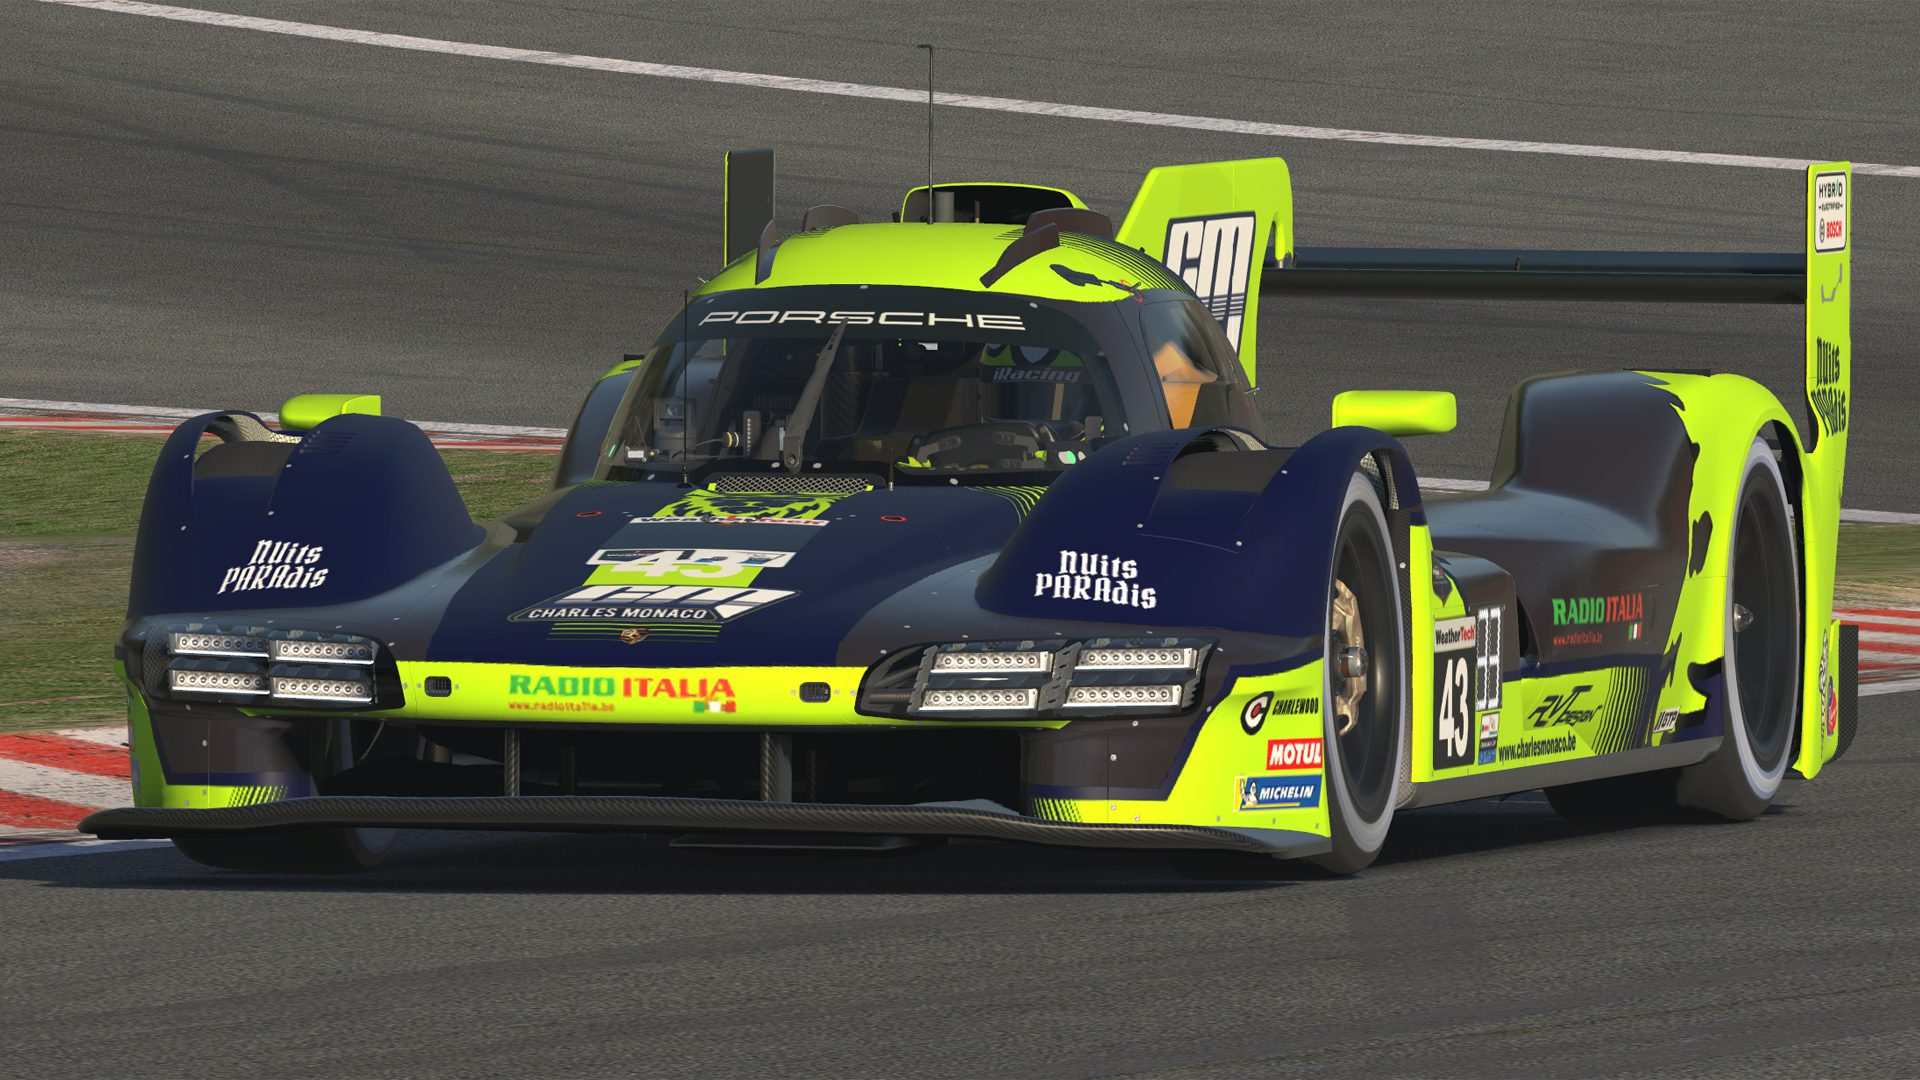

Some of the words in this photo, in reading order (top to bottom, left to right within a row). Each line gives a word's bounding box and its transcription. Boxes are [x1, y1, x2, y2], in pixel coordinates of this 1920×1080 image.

[1826, 221, 1842, 239] BOSCH
[698, 310, 1026, 331] PORSCHE
[992, 367, 1081, 383] iRacing
[611, 550, 744, 579] 43
[528, 607, 617, 619] CHARLES
[621, 607, 707, 620] MONACO
[1552, 597, 1605, 625] RADIO
[1605, 592, 1643, 623] ITALIA
[1435, 625, 1475, 645] WeatherTech
[509, 674, 615, 696] RADIO
[623, 677, 736, 698] ITALIA
[509, 700, 615, 712] www.radioitalia.be
[1272, 697, 1319, 716] CHARLEWOOD
[1438, 657, 1469, 758] 43
[1269, 742, 1322, 766] MOTUL
[1499, 730, 1577, 762] www.charlesmonaco.be
[1258, 785, 1314, 800] MICHELIN
